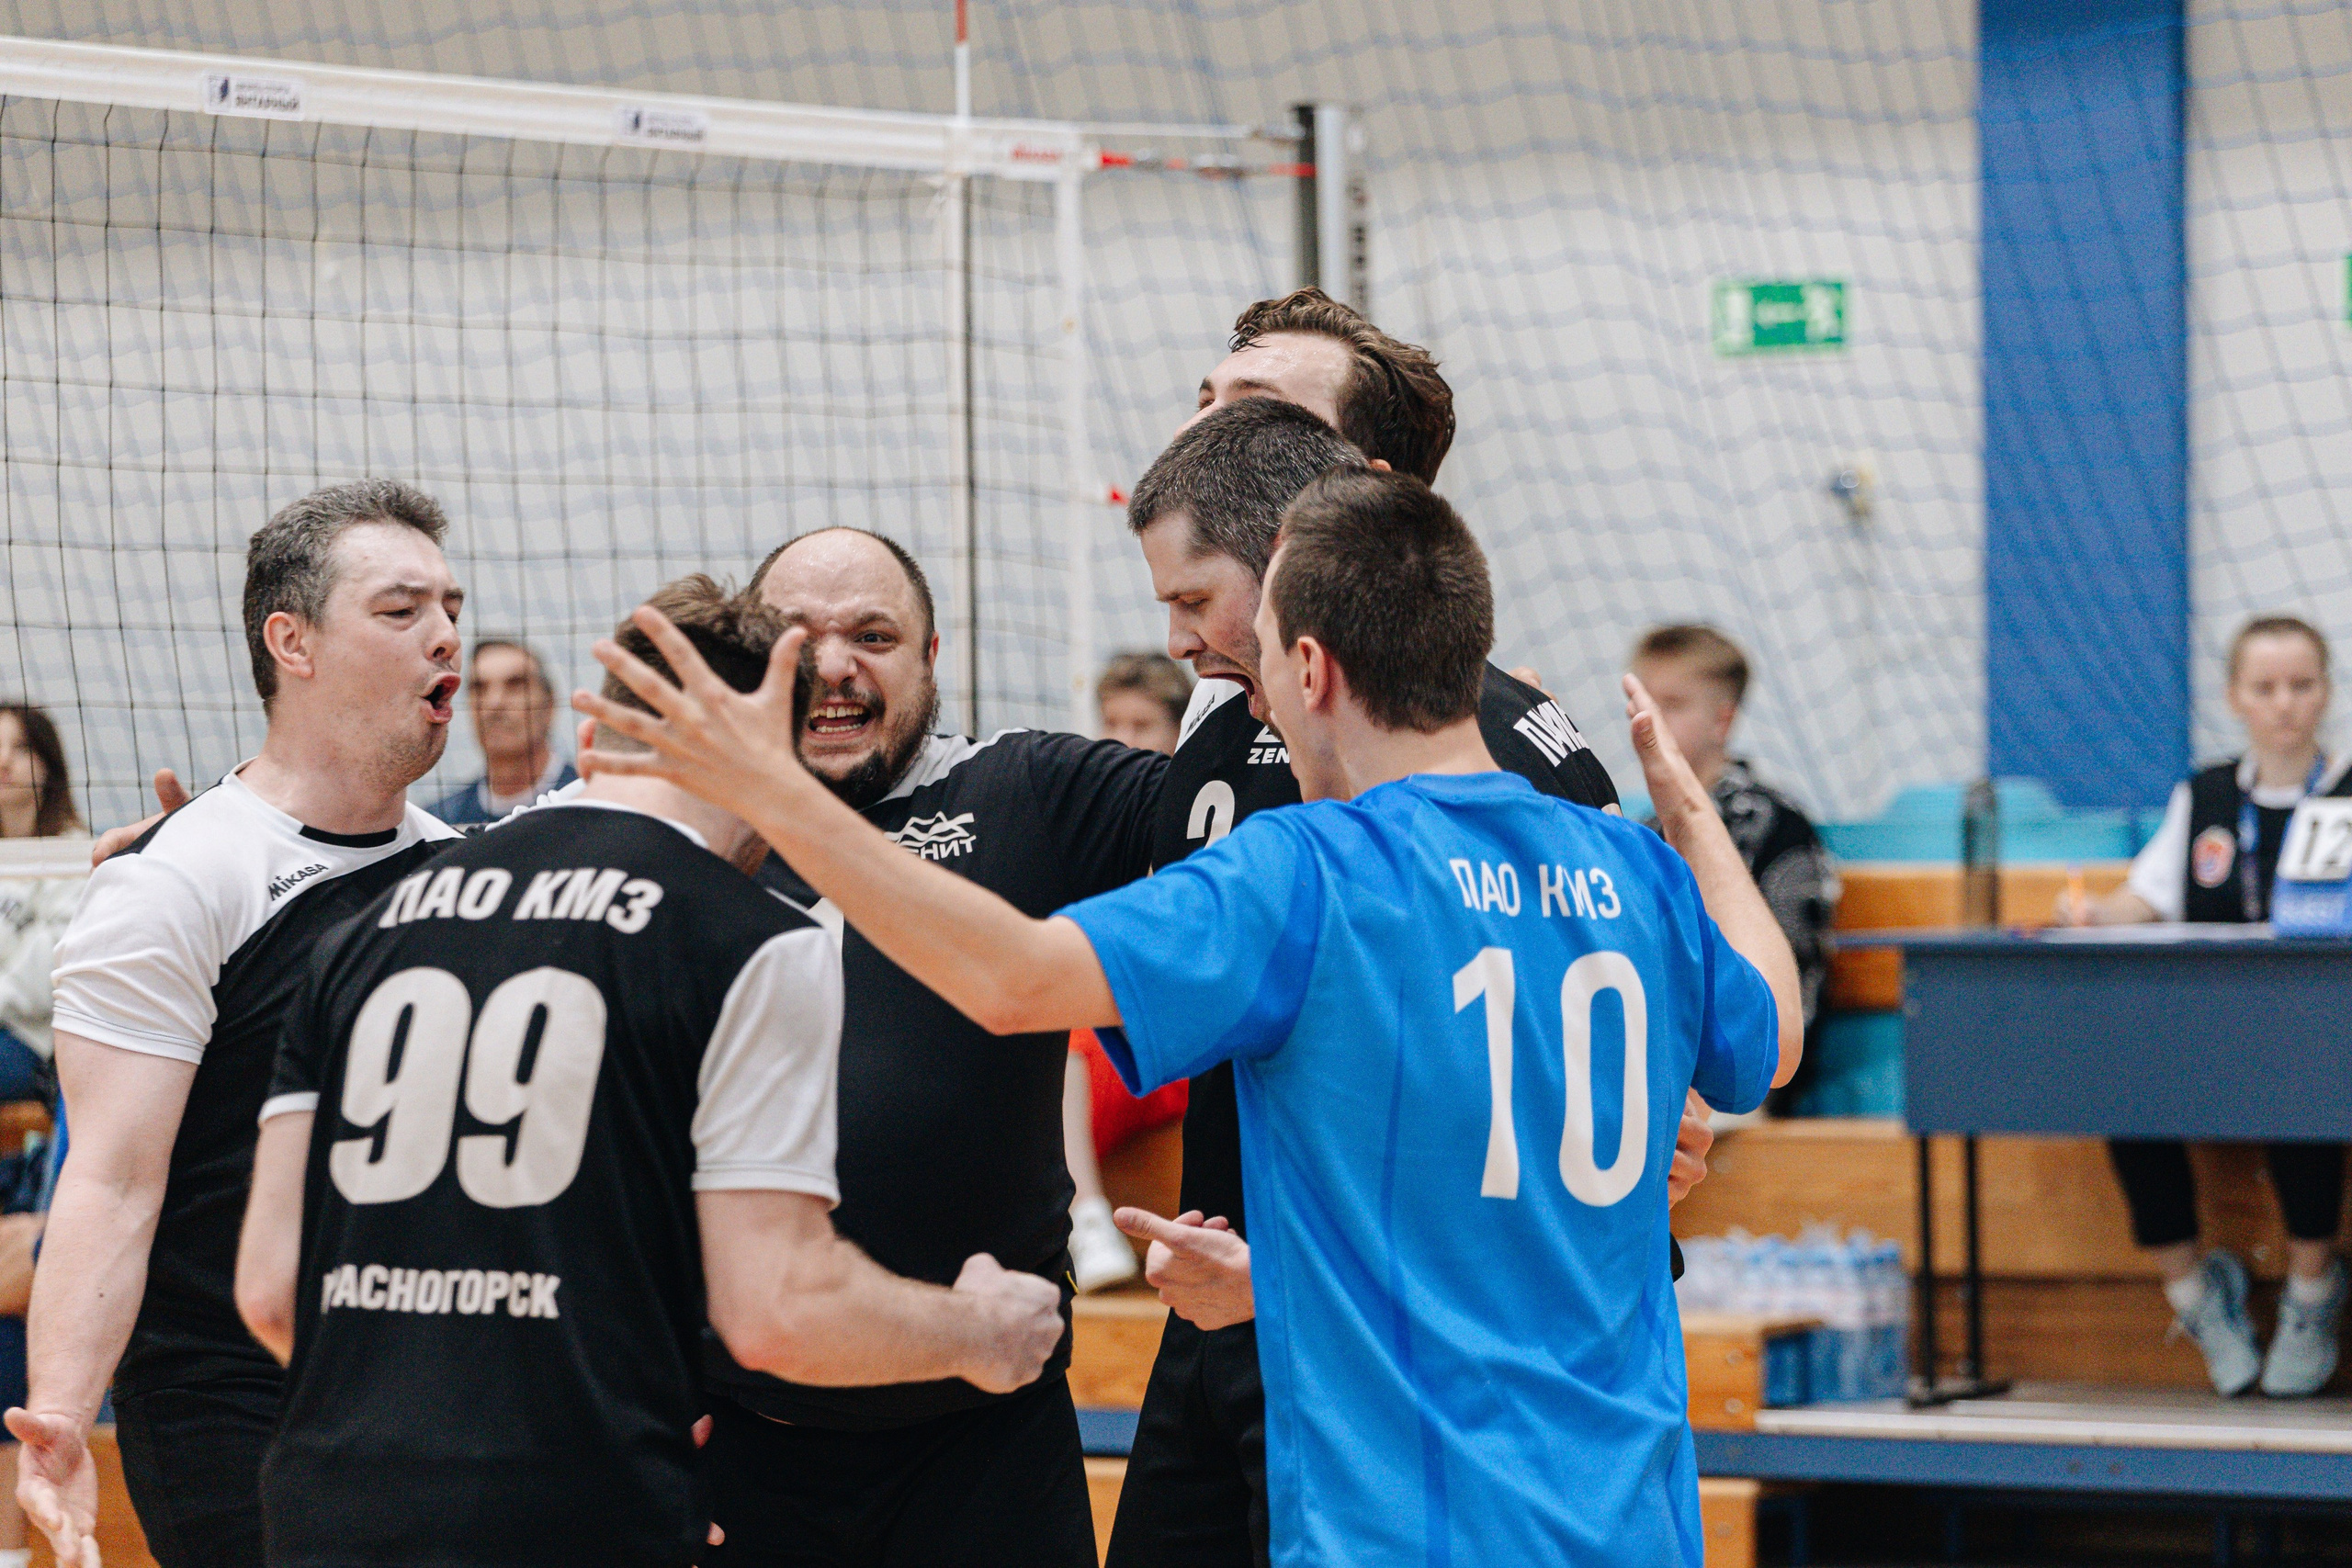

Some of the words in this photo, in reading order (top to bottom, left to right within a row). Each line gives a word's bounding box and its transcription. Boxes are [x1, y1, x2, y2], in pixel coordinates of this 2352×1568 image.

[1247, 748, 1291, 764] ZEN
[908, 834, 977, 861] НИТ
[378, 866, 513, 929] ПАО
[512, 867, 663, 934] КМЗ
[1449, 858, 1521, 918] ПАО
[1538, 863, 1623, 920] КМЗ
[329, 965, 608, 1210] 99
[1452, 946, 1649, 1208] 10
